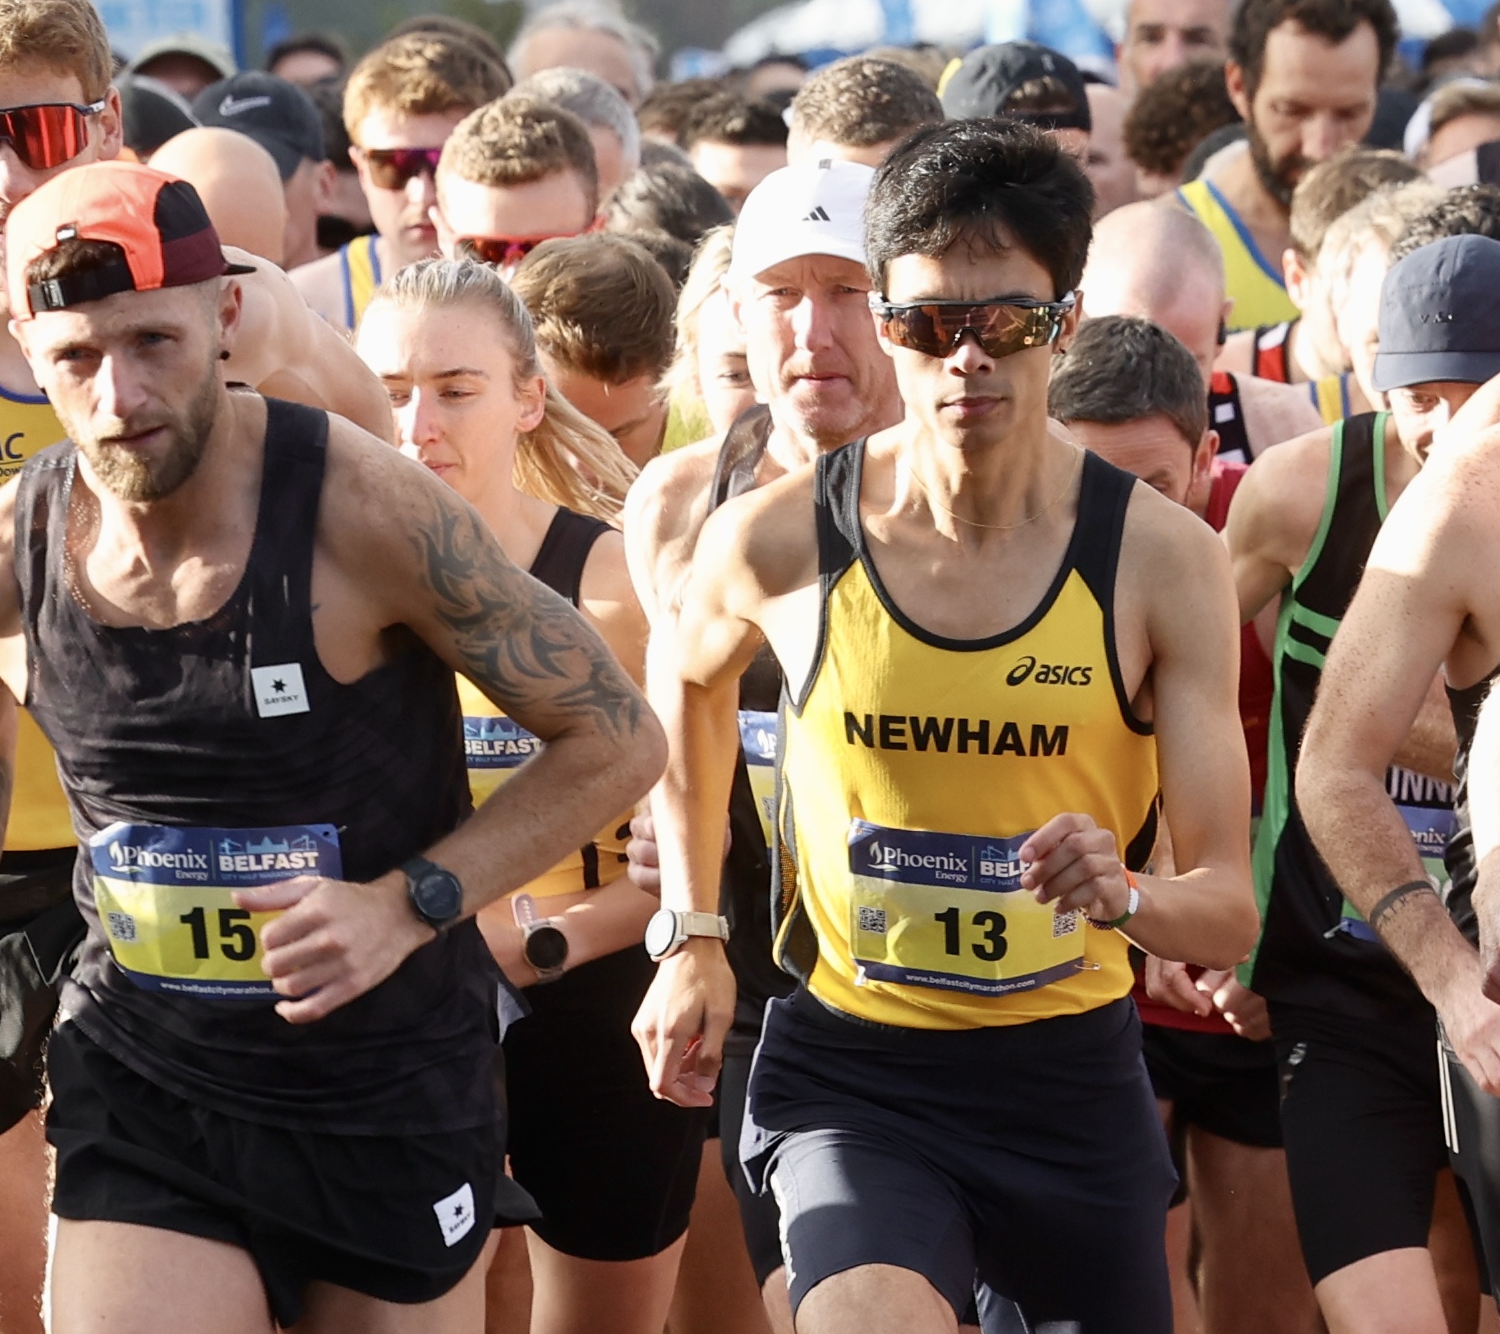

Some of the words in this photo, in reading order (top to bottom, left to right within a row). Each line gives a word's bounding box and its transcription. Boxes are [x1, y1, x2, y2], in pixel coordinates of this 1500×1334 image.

[1034, 664, 1093, 686] asics
[843, 711, 1070, 757] NEWHAM
[124, 844, 208, 869] Phoenix
[218, 851, 319, 873] BELFAST
[883, 845, 968, 872] Phoenix
[175, 869, 209, 881] Energy
[935, 870, 968, 883] Energy
[979, 860, 1032, 878] BELF
[179, 906, 257, 962] 15
[934, 906, 1008, 962] 13
[160, 981, 277, 997] www.belfastcitymarathon.
[905, 972, 1036, 992] www.belfastcitymarathon.com
